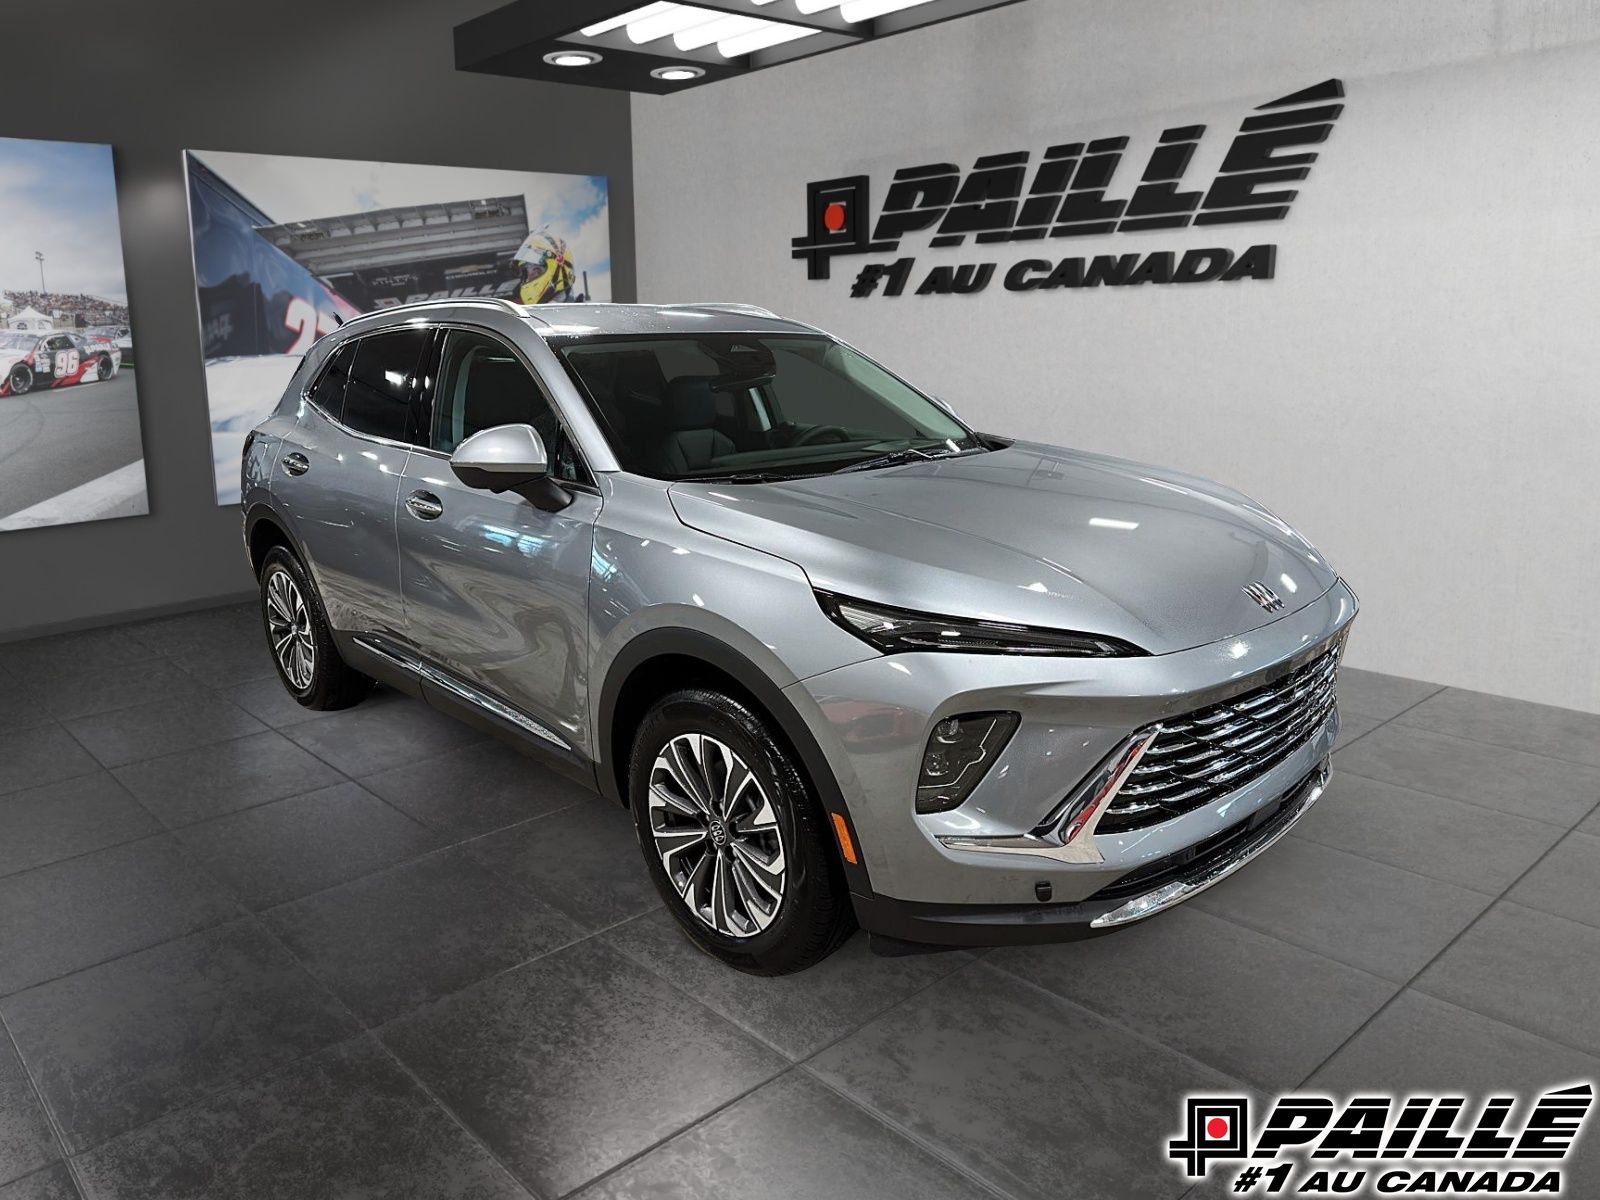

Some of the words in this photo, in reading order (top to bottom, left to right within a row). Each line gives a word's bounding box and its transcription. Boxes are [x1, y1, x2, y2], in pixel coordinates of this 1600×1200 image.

[869, 77, 1346, 251] PAILLÉ
[850, 256, 916, 298] #1
[914, 262, 997, 296] AU
[1003, 243, 1277, 292] CANADA
[54, 349, 80, 378] 96
